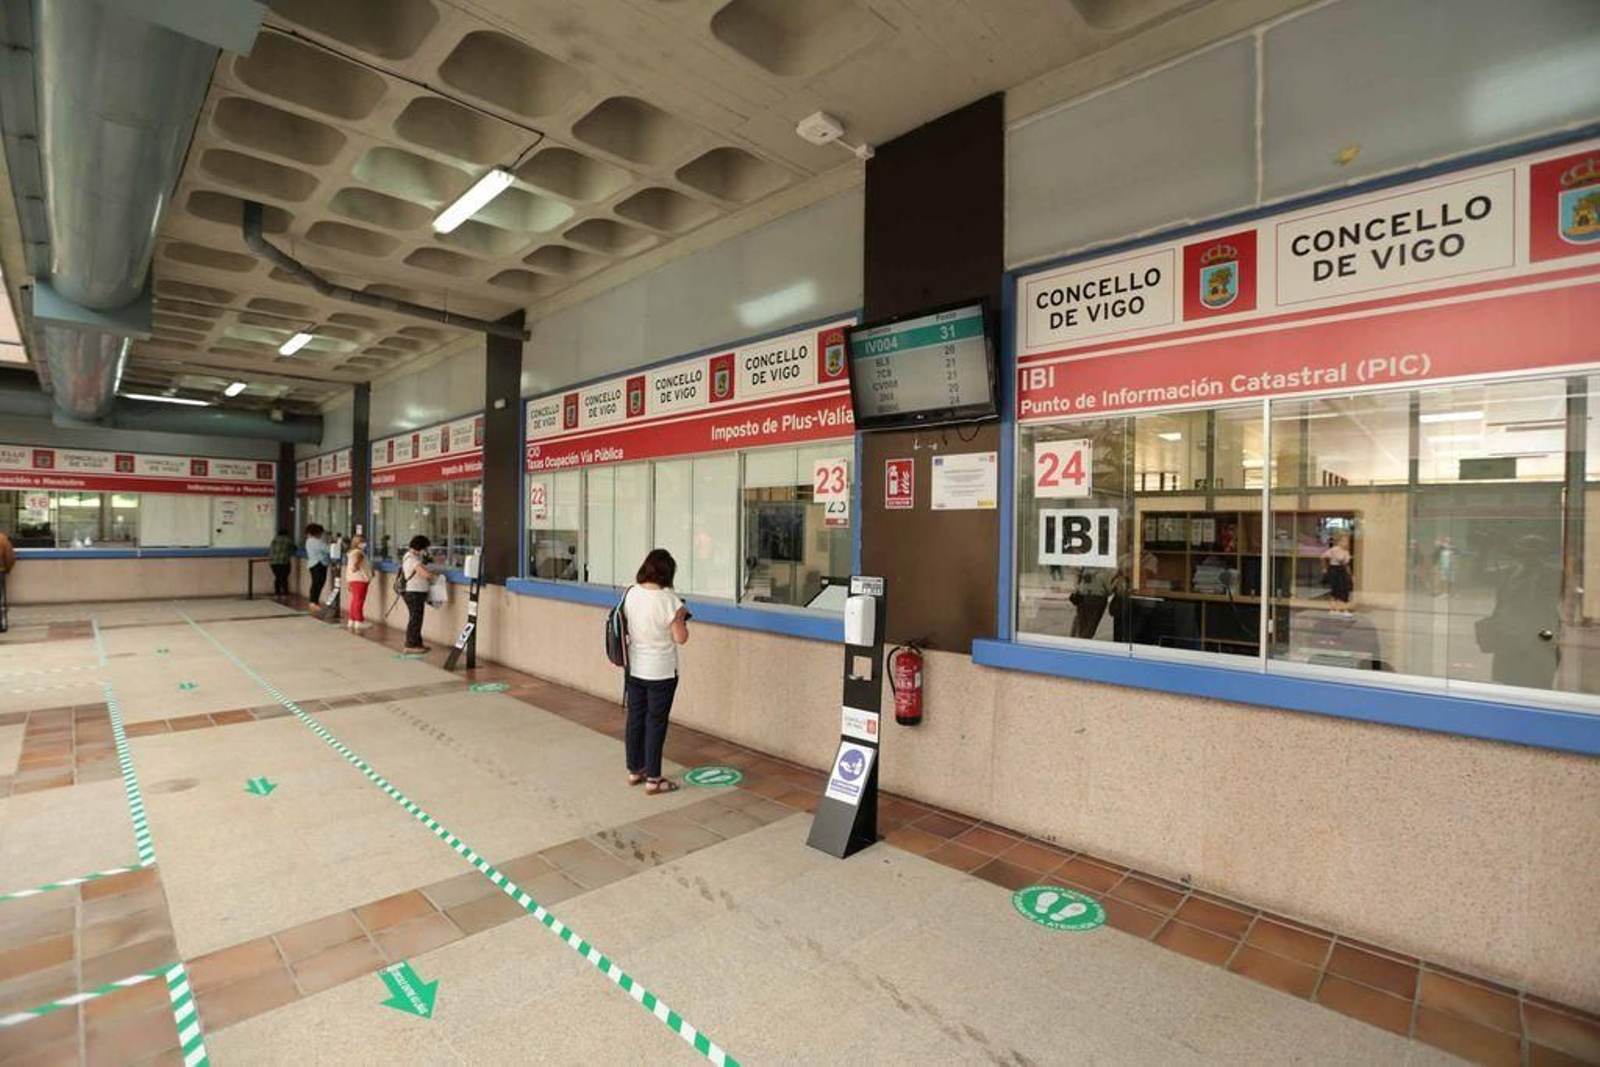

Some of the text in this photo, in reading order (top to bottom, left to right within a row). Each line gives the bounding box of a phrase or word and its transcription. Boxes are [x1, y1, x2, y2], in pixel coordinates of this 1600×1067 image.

[1291, 195, 1492, 257] CONCELLO
[1313, 233, 1466, 282] DE VIGO
[1036, 267, 1162, 310] CONCELLO
[1050, 295, 1145, 330] DE VIGO
[940, 324, 956, 340] 31
[745, 346, 808, 371] CONCELLO
[655, 369, 702, 391] CONCELLO
[752, 365, 800, 386] DE VIGO
[1020, 352, 1431, 415] Punto de Información Catastral (PIC)
[1022, 366, 1055, 391] IBI
[585, 389, 622, 407] CONCELLO
[660, 386, 697, 404] DE VIGO
[530, 404, 560, 420] CONCELLO
[533, 415, 557, 430] DE VIGO
[588, 403, 617, 419] DE VIGO
[711, 405, 855, 443] Imposto de Plus-Valía
[545, 451, 579, 468] Ocupación
[581, 450, 594, 463] Vía
[595, 446, 624, 462] Pública
[1037, 450, 1086, 488] 24
[816, 466, 845, 494] 23
[532, 487, 544, 505] 22
[1044, 515, 1110, 556] IBI
